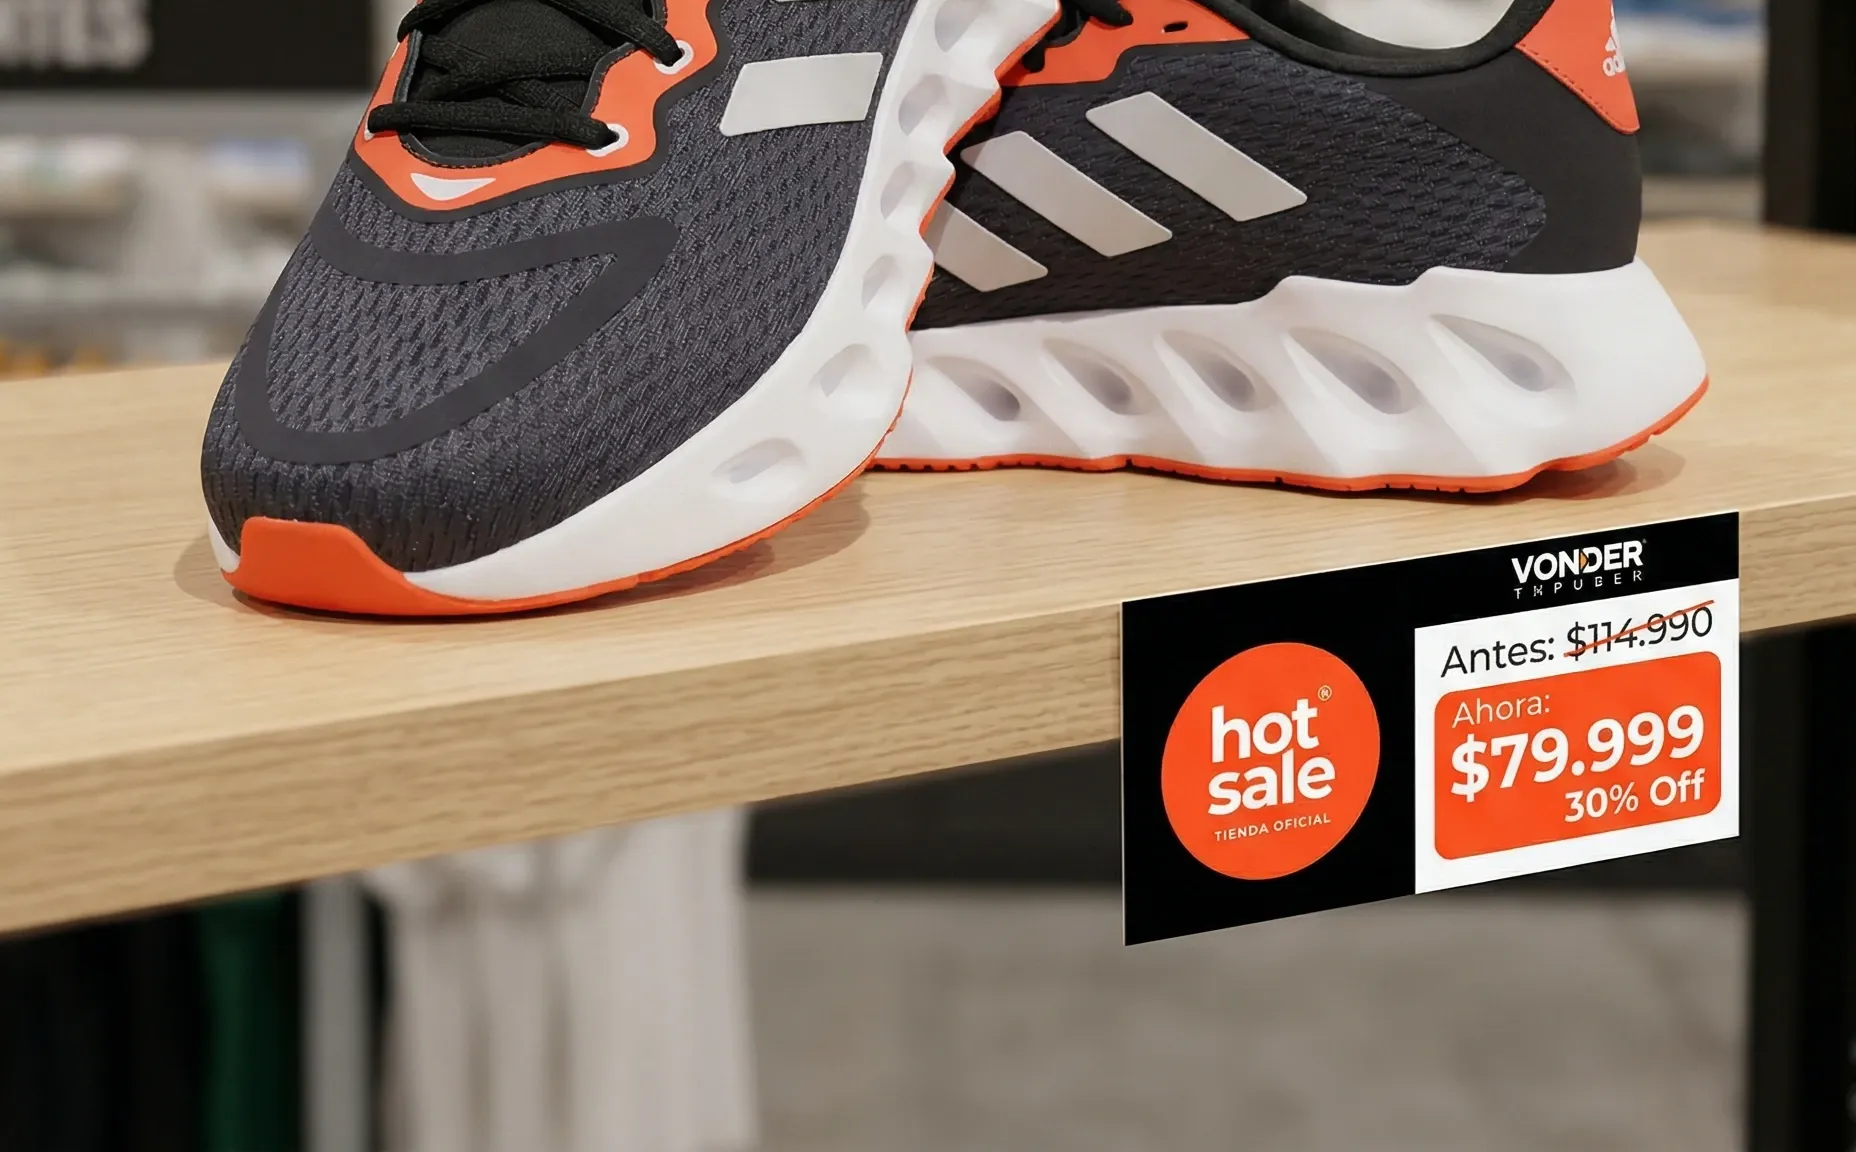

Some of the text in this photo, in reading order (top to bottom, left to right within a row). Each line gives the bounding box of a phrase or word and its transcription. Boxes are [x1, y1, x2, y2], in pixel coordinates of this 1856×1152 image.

[1511, 540, 1644, 584] VONDER
[1440, 606, 1713, 678] Antes: $114.990
[1211, 698, 1320, 763] hot
[1452, 693, 1551, 728] Ahora:
[1207, 748, 1336, 816] sale
[1451, 705, 1704, 803] $79.999
[1564, 768, 1705, 823] 30% Off
[1214, 812, 1332, 841] TIENDA OFICIAL
